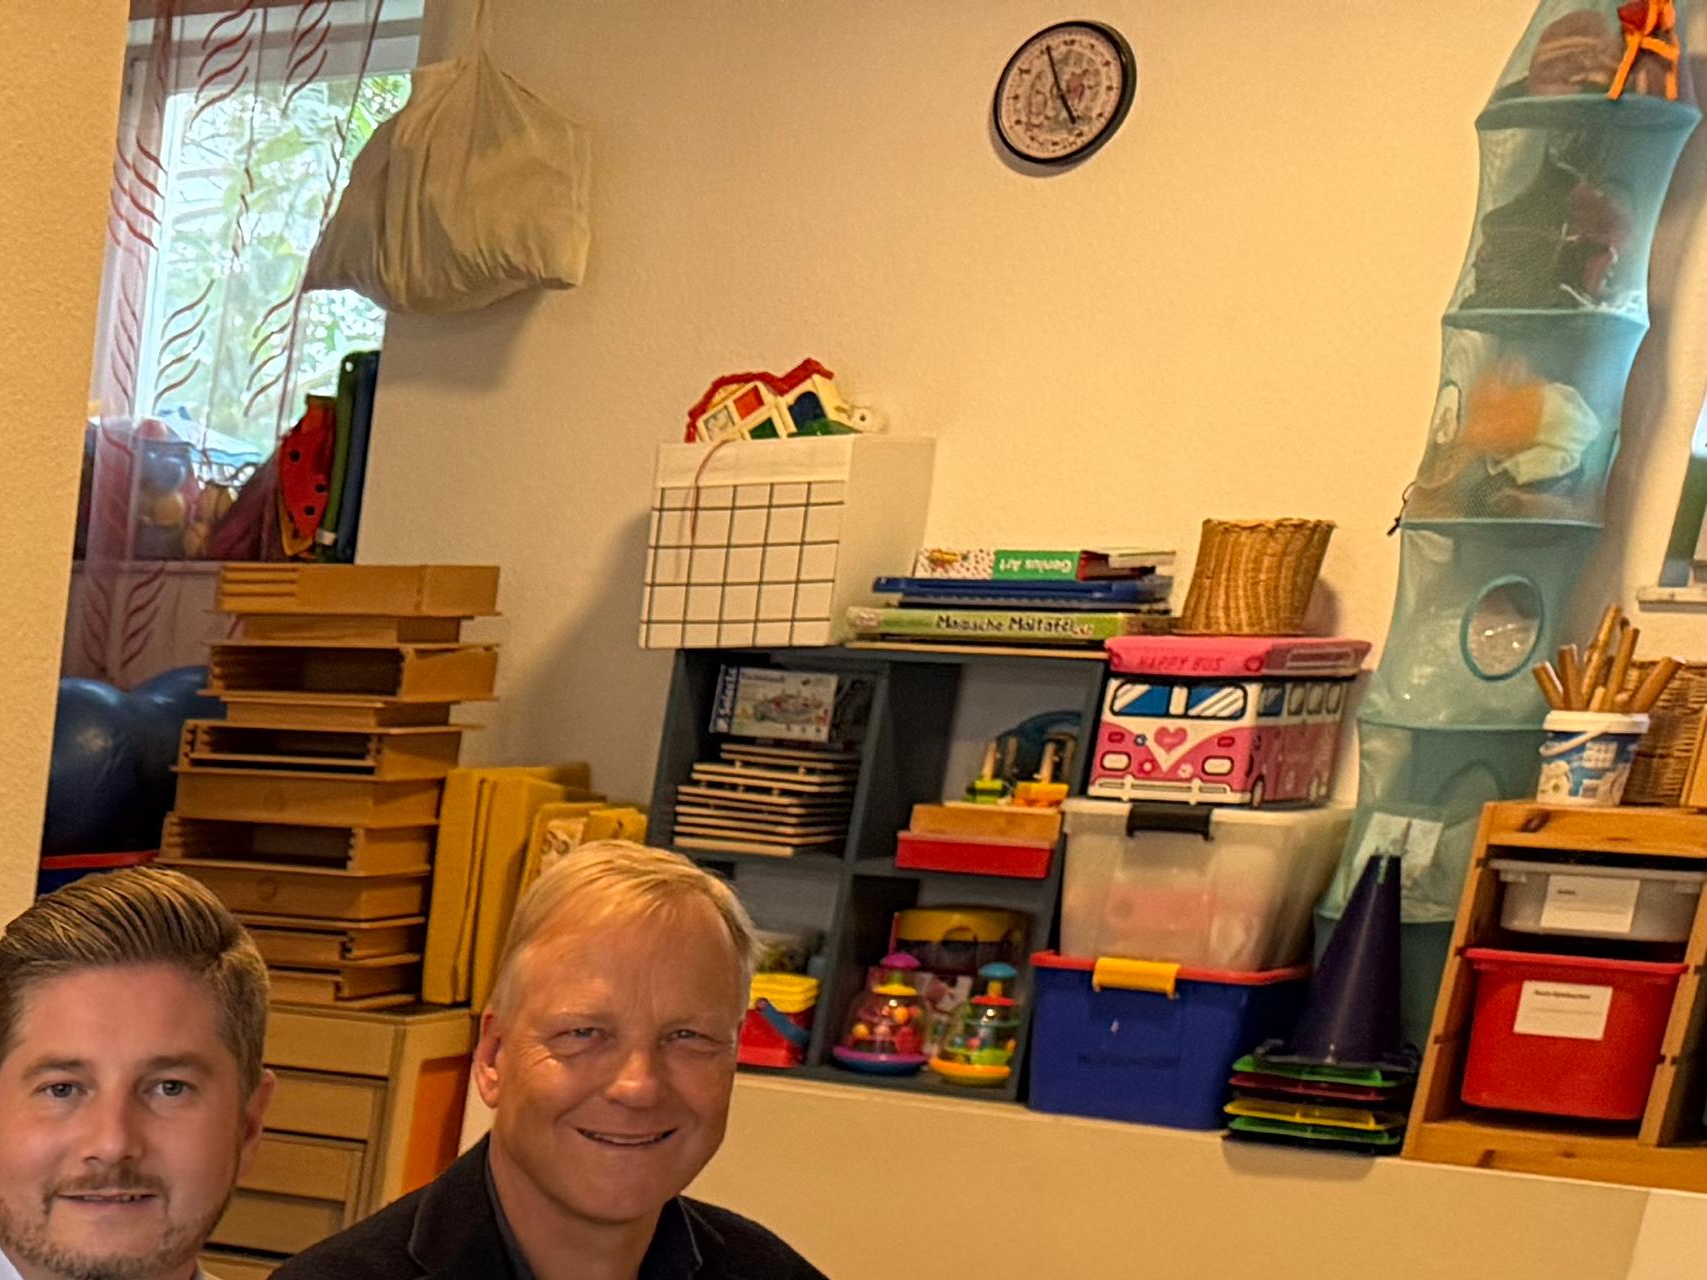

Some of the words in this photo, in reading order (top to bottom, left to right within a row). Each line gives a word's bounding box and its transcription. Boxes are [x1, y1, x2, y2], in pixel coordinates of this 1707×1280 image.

[999, 558, 1022, 573] Art
[1025, 558, 1072, 574] Genius
[1192, 656, 1225, 672] BUS
